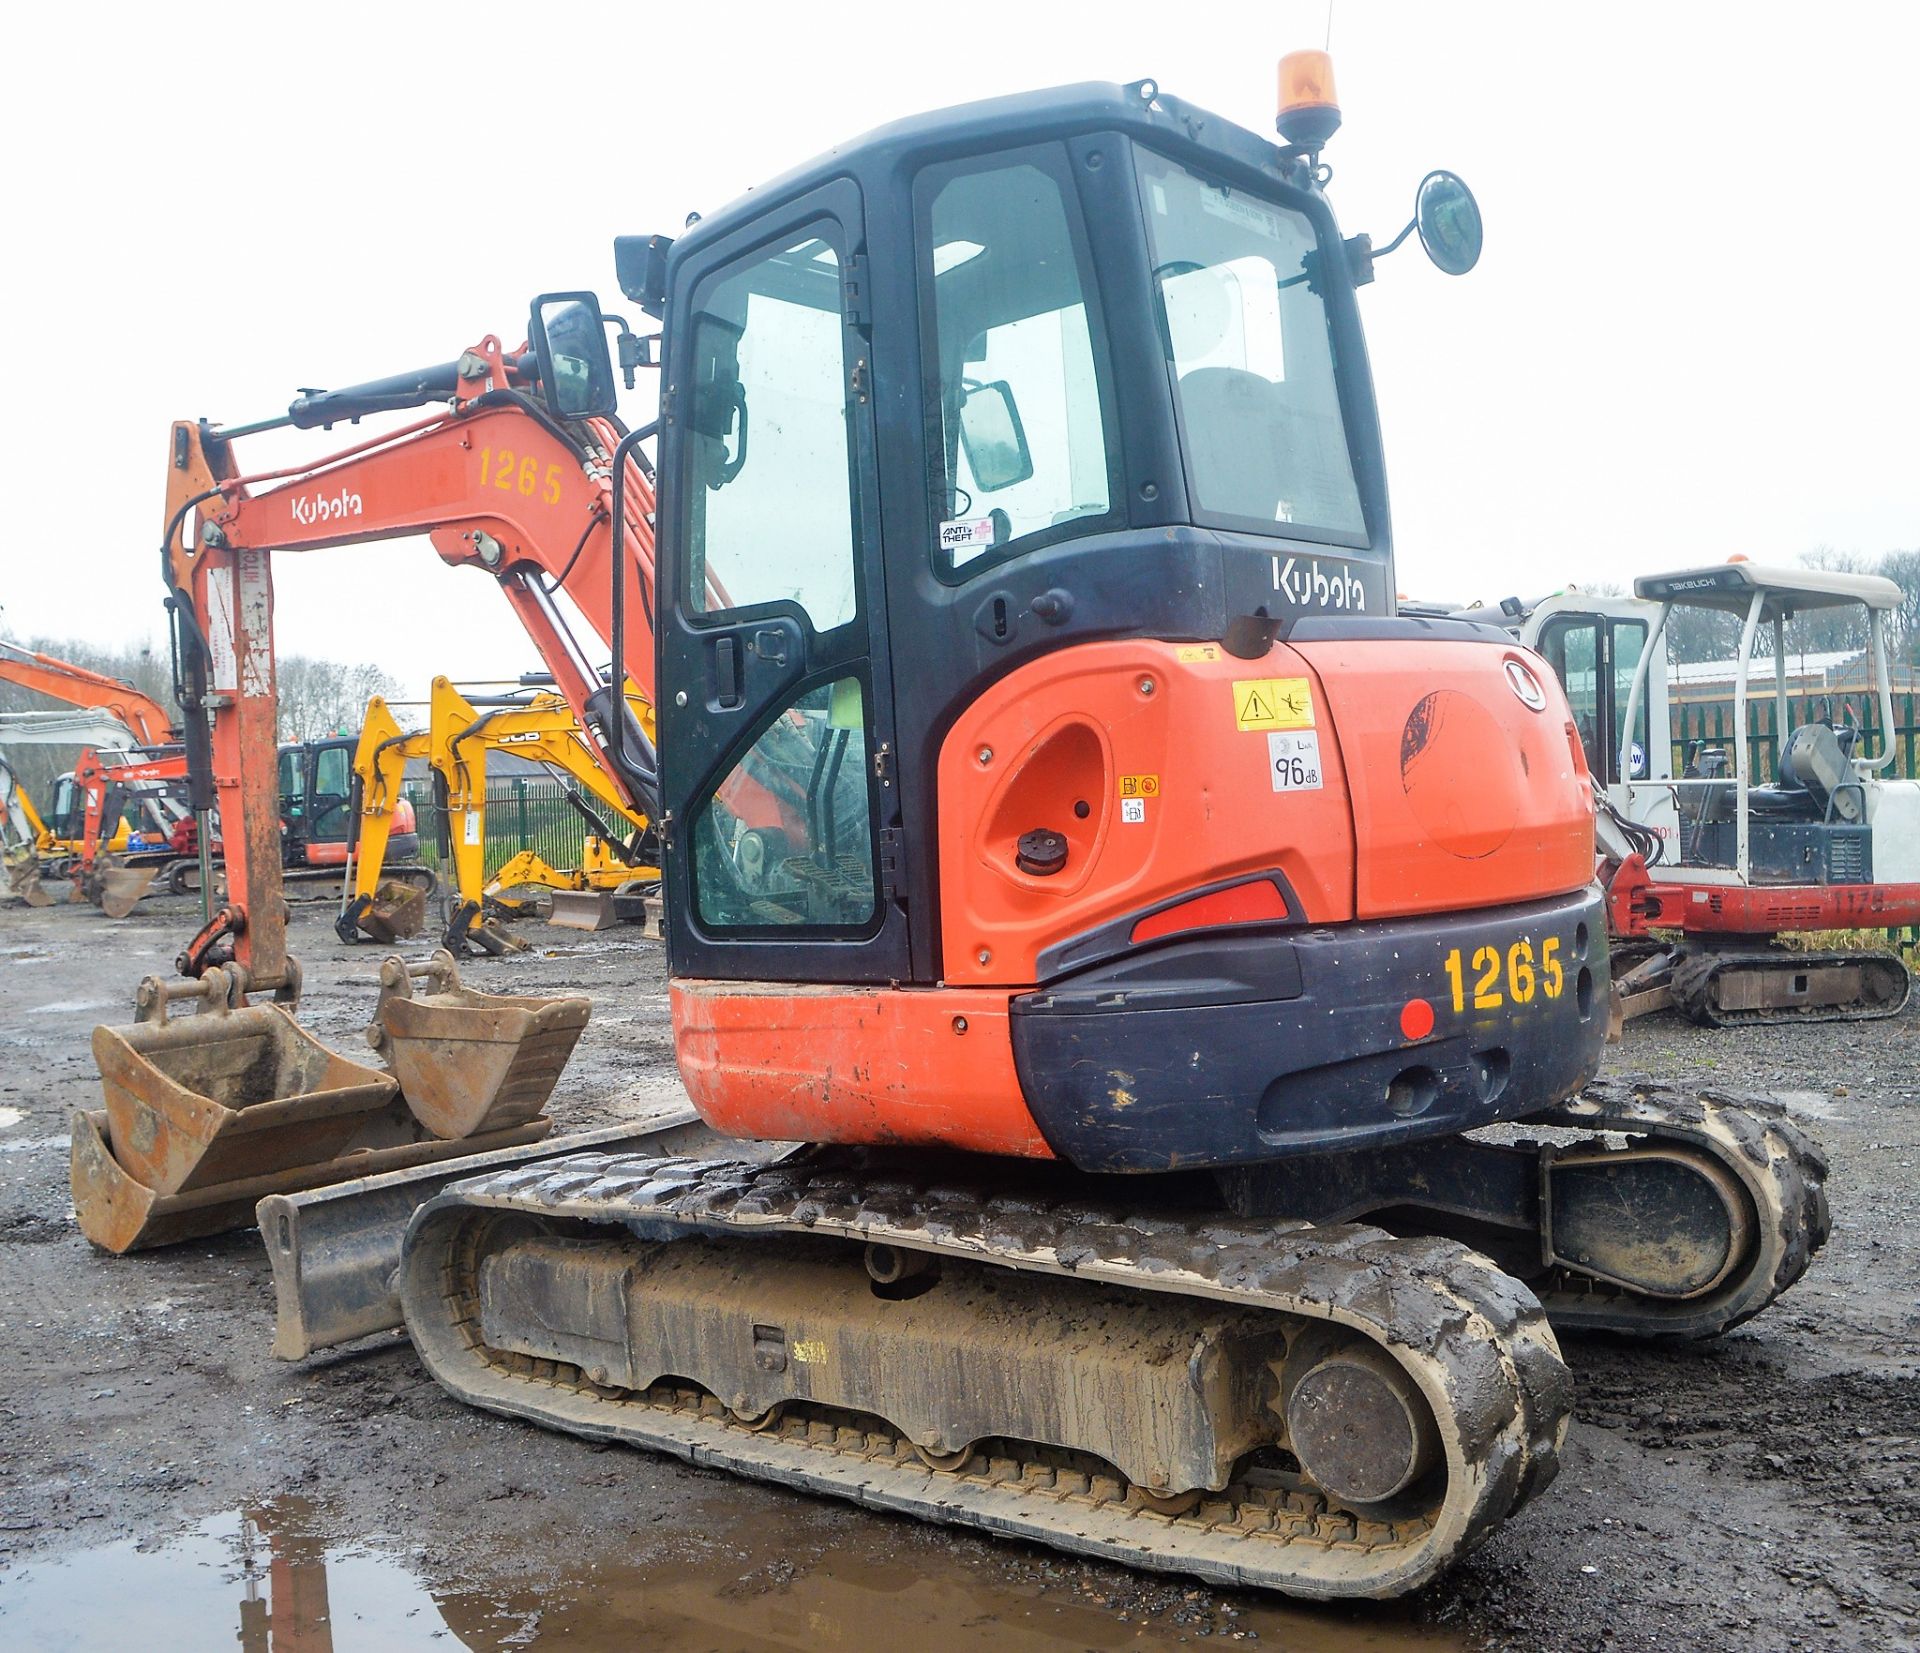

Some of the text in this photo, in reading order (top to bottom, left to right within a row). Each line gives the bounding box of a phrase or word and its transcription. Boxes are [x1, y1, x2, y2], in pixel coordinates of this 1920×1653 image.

[480, 447, 563, 505] 1265
[291, 487, 362, 525] Kubota
[943, 533, 972, 543] THEFT
[1272, 556, 1365, 611] Kubota
[1276, 757, 1318, 786] 96 dB
[1444, 937, 1563, 1013] 1265
